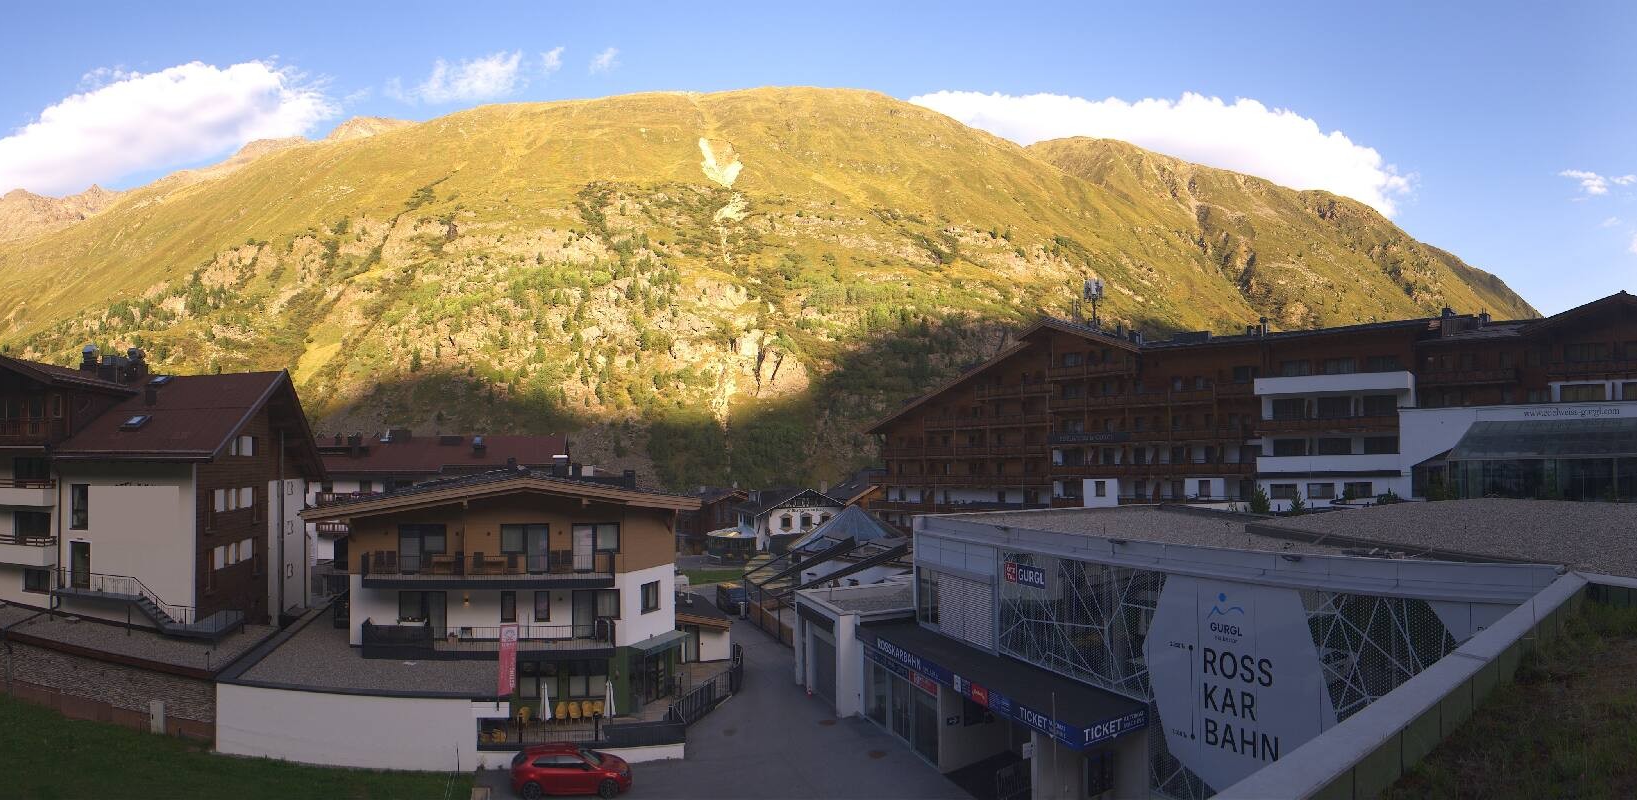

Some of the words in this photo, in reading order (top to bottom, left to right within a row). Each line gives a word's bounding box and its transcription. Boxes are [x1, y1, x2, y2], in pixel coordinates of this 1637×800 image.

[1018, 568, 1045, 585] GURGL
[1210, 622, 1242, 637] GURGL
[877, 638, 921, 671] ROSSKARBAHN
[1203, 647, 1273, 688] ROSS
[1204, 682, 1257, 722] KAR
[1019, 706, 1047, 730] TICKET
[1083, 717, 1122, 742] TICKET
[1205, 718, 1279, 762] BAHN
